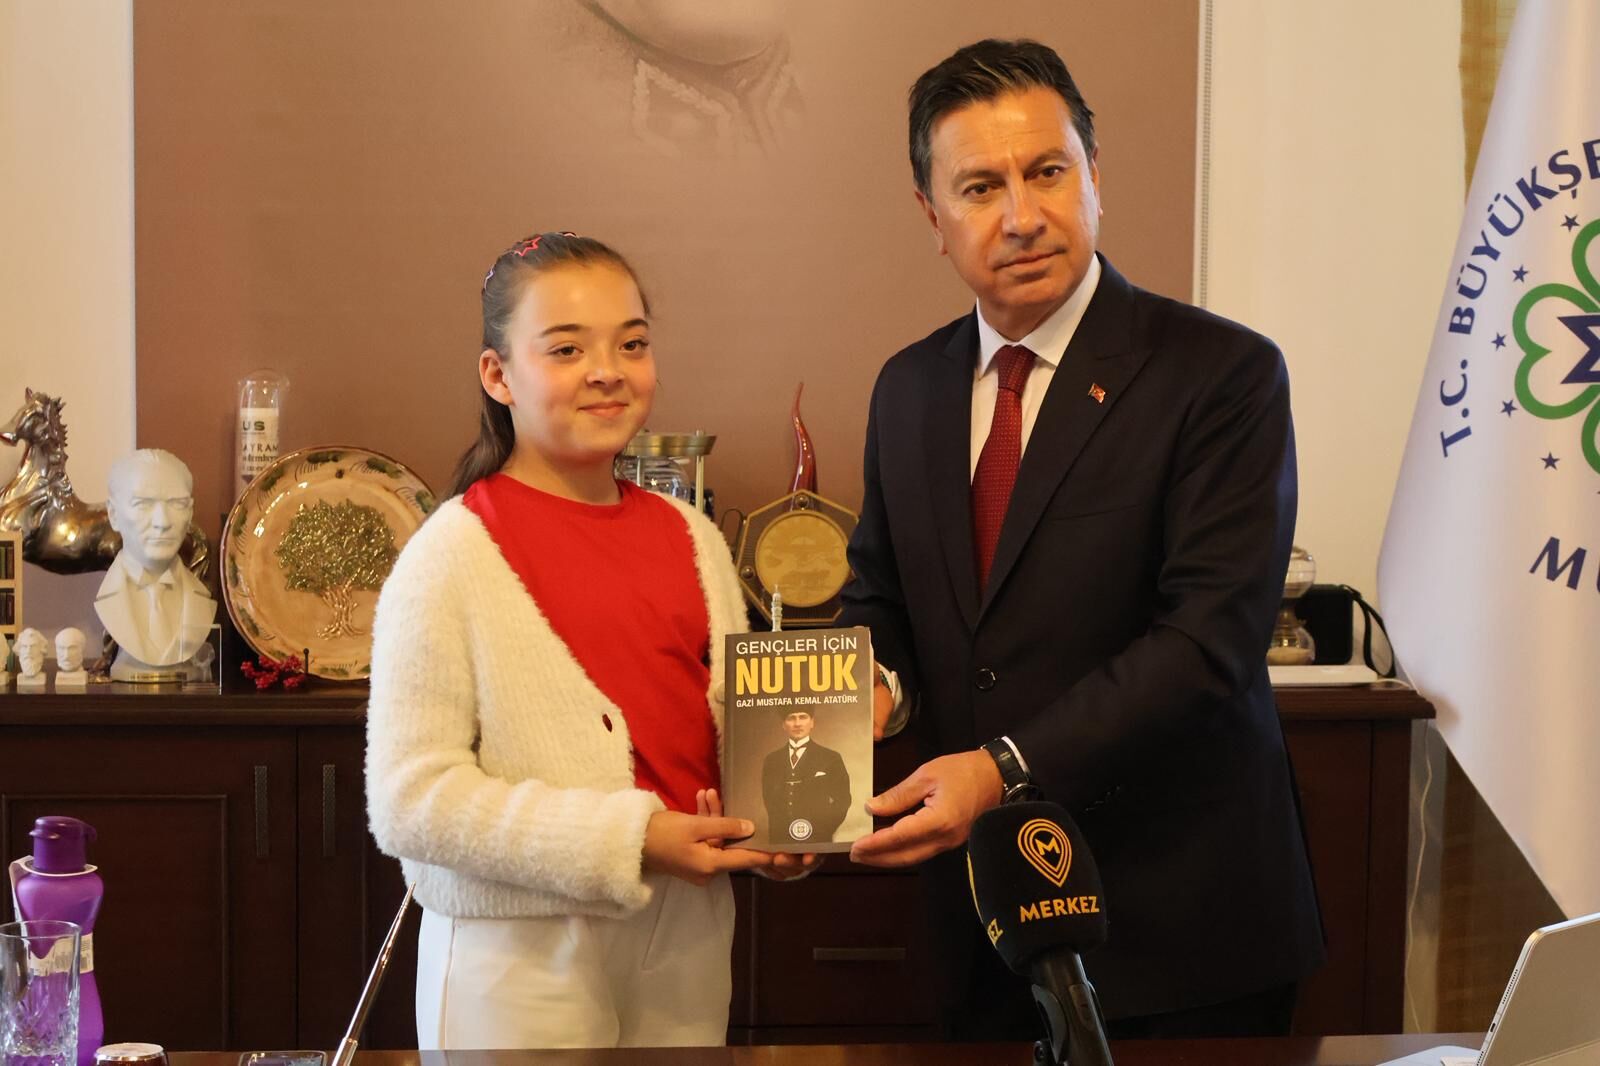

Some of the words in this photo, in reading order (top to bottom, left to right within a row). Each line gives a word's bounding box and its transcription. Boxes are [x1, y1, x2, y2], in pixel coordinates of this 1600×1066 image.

[1440, 359, 1472, 458] T.C.
[1529, 536, 1600, 593] M
[736, 638, 818, 656] GENÇLER
[823, 634, 858, 654] İÇİN
[735, 653, 858, 696] NUTUK
[736, 697, 754, 708] GAZİ
[757, 697, 793, 707] MUSTAFA
[795, 695, 822, 705] KEMAL
[824, 693, 858, 704] ATATÜRK
[1020, 895, 1100, 923] MERKEZ
